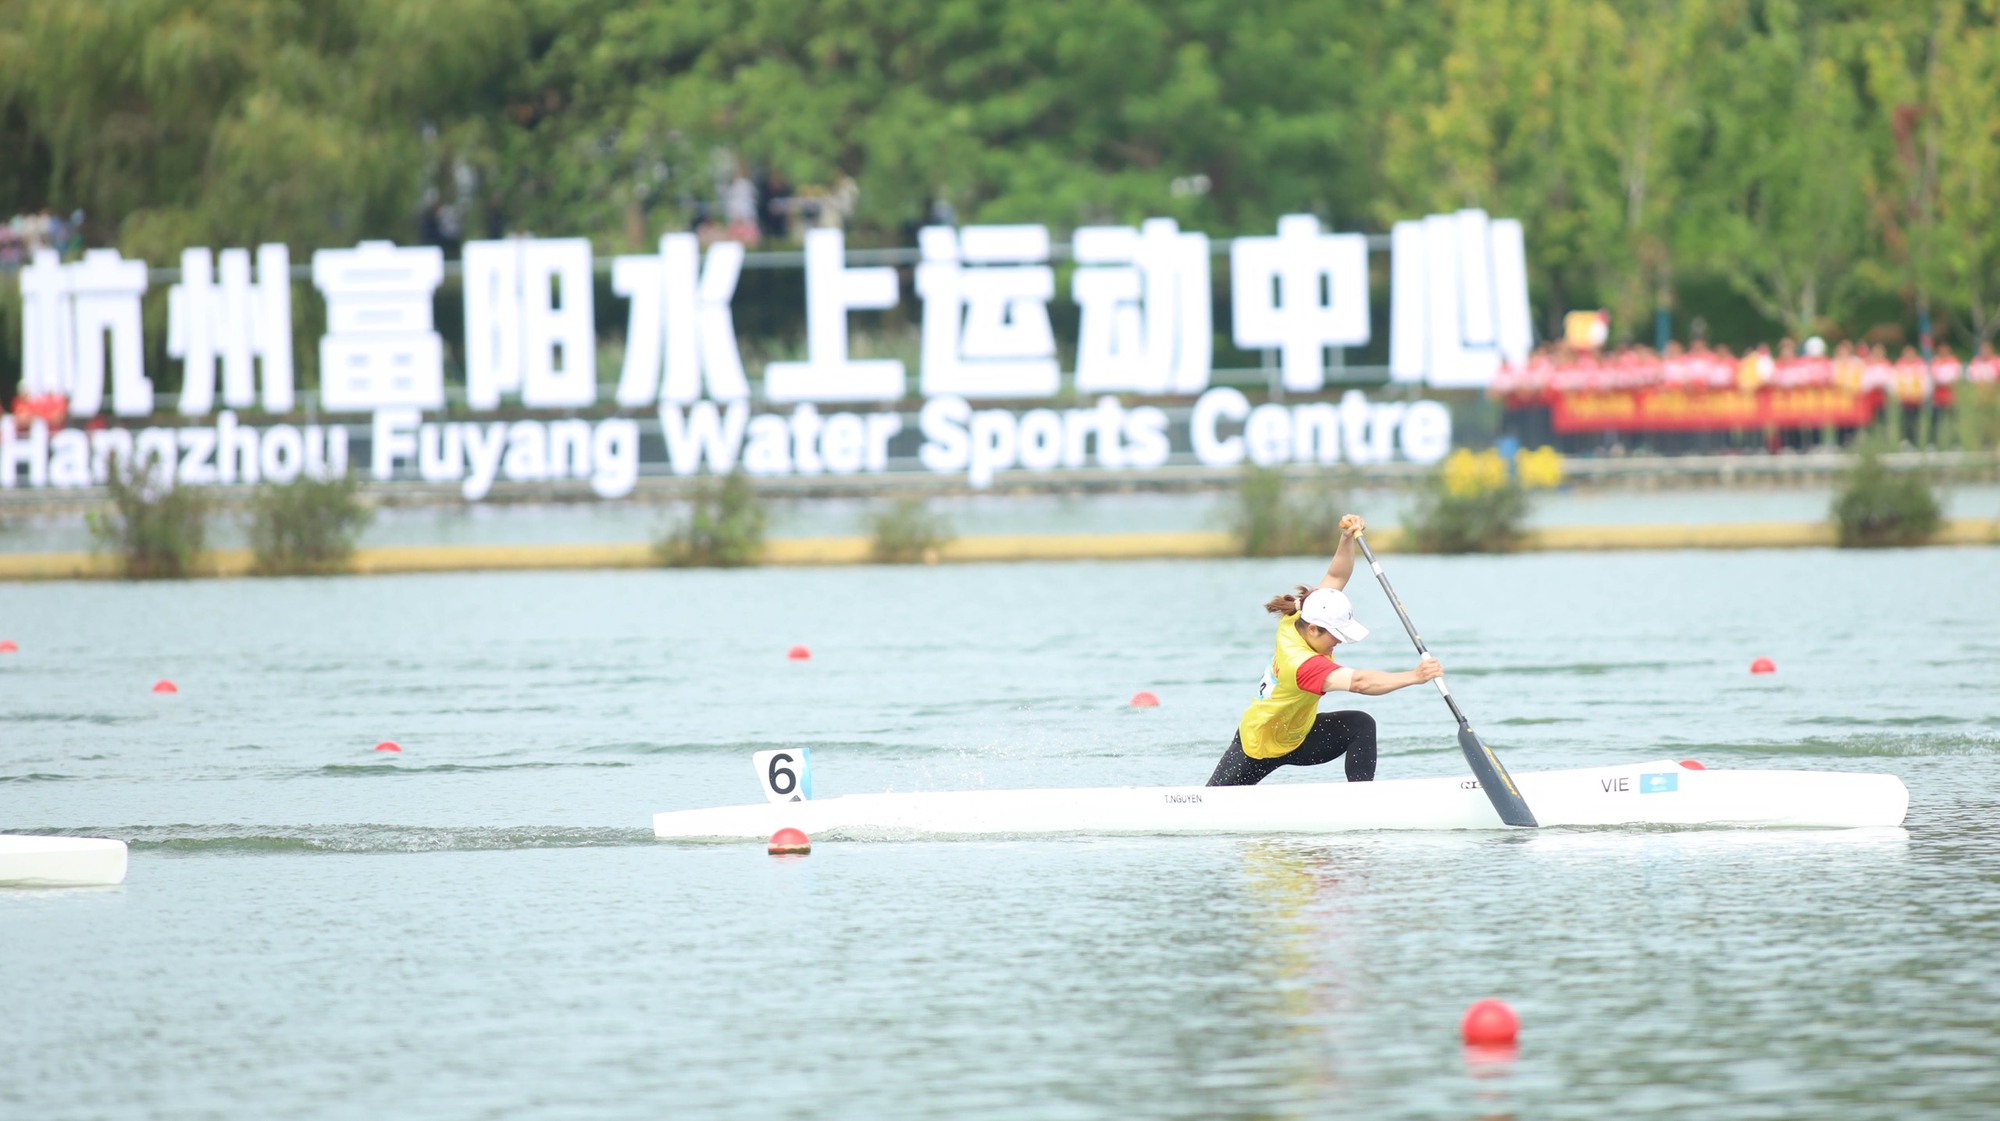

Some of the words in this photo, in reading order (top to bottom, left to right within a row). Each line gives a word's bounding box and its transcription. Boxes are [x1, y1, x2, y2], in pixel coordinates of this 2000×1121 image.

[19, 207, 1533, 418] 杭州富阳水上运动中心
[0, 409, 348, 502] Hangzhou
[370, 406, 641, 498] Fuyang
[657, 396, 903, 477] Water
[917, 394, 1171, 488] Sports
[1189, 386, 1453, 467] Centre
[768, 752, 797, 795] 6
[1601, 777, 1630, 793] VIE
[1164, 794, 1203, 804] T.NGUYEN
